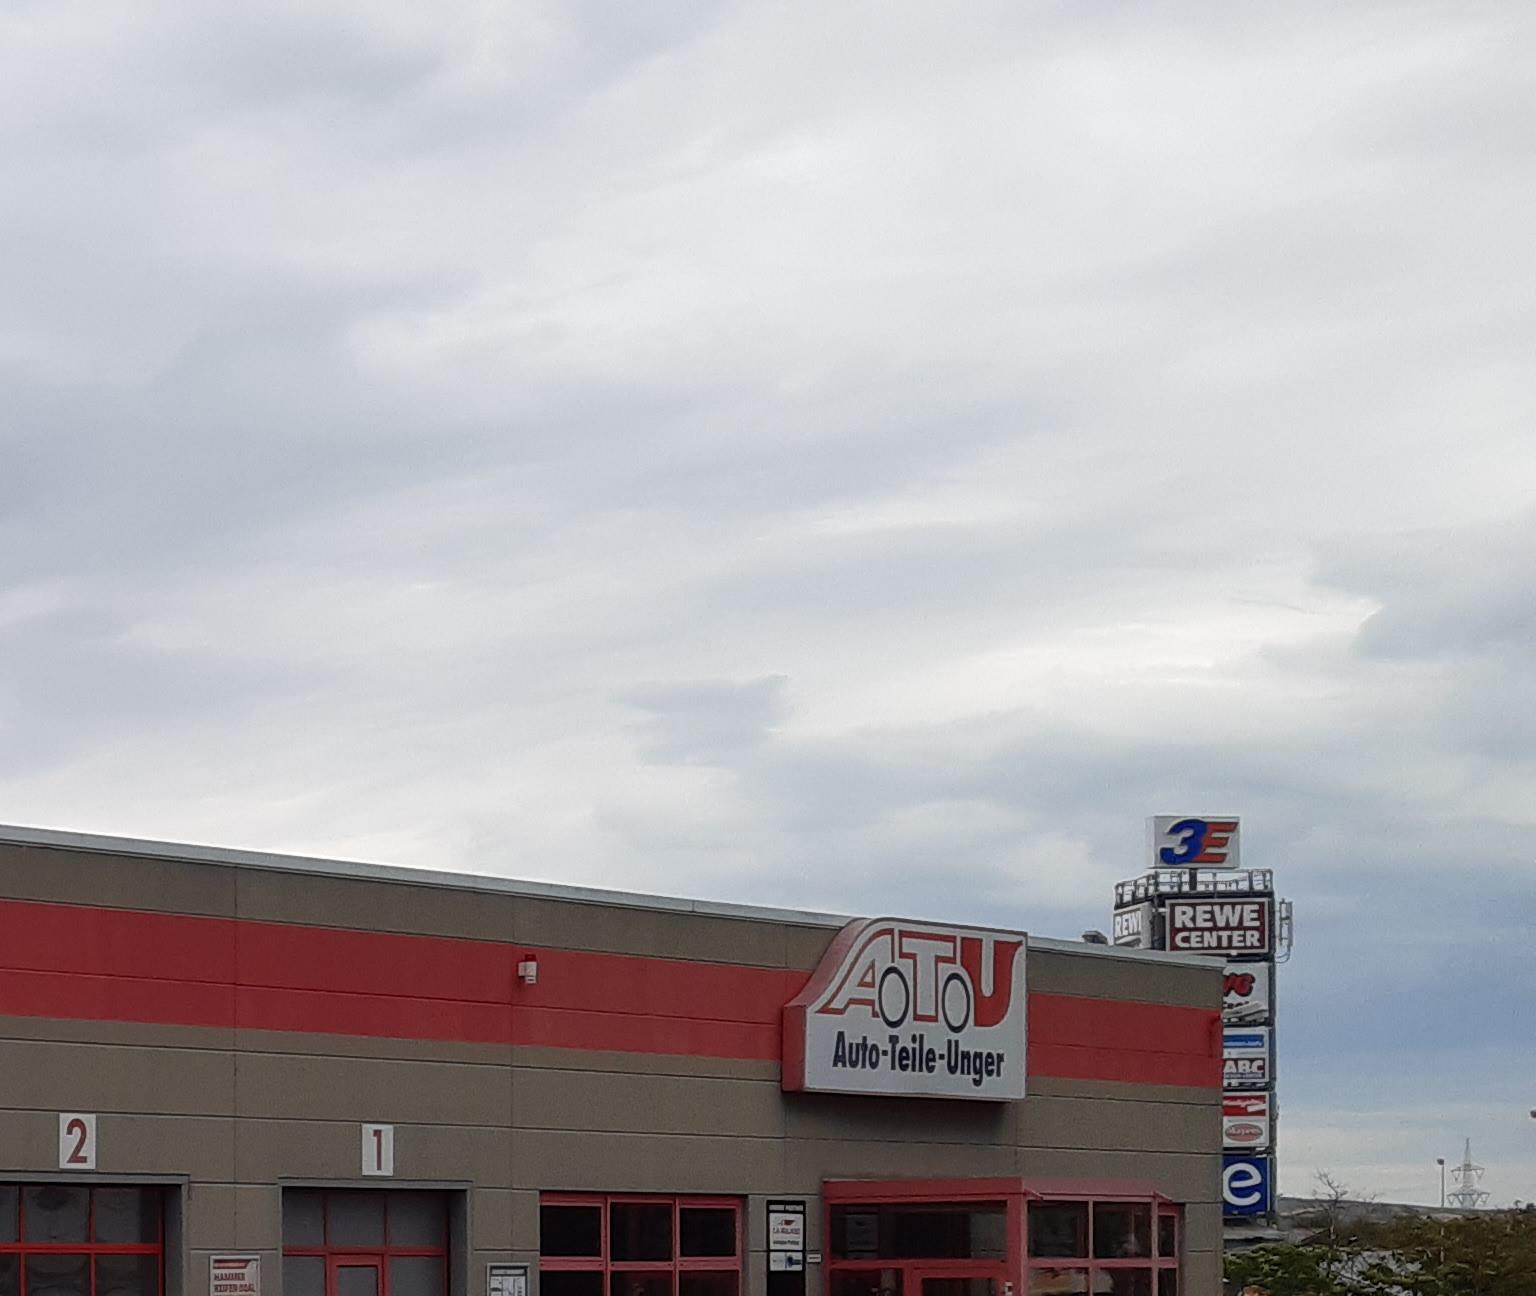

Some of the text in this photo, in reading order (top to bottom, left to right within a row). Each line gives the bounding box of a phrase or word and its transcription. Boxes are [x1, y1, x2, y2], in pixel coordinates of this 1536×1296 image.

[1159, 819, 1239, 865] 3E
[1174, 904, 1261, 928] REWE
[1174, 930, 1261, 948] CENTER
[832, 1031, 1005, 1087] Auto-Teile-Unger
[66, 1118, 89, 1165] 2
[372, 1128, 385, 1171] 1
